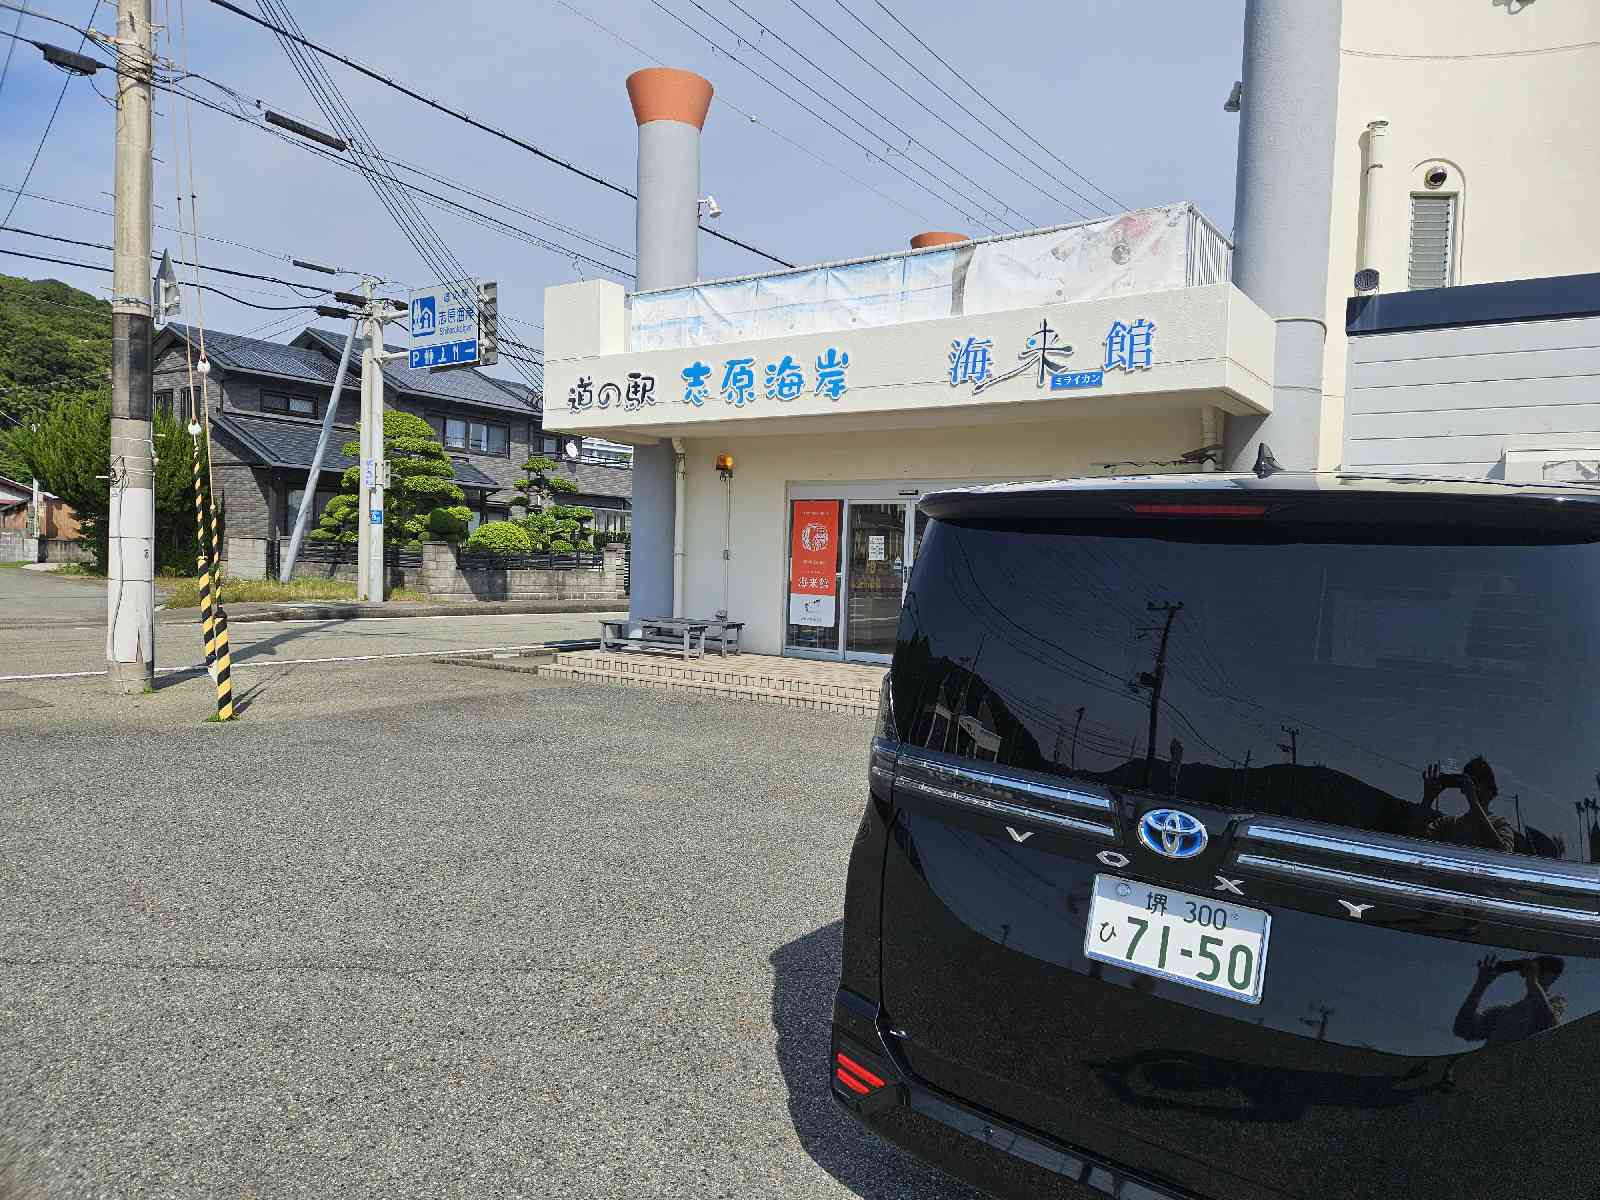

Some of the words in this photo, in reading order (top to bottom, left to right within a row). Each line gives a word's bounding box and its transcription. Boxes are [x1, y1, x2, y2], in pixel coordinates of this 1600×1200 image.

[567, 372, 656, 413] 道の駅
[681, 347, 849, 406] 志原海岸
[1055, 374, 1101, 385] ミライカン
[1005, 825, 1375, 919] VOXY
[1145, 891, 1169, 917] 堺
[1184, 901, 1228, 931] 300
[1099, 921, 1117, 943] ひ
[1125, 915, 1254, 991] 71-50
